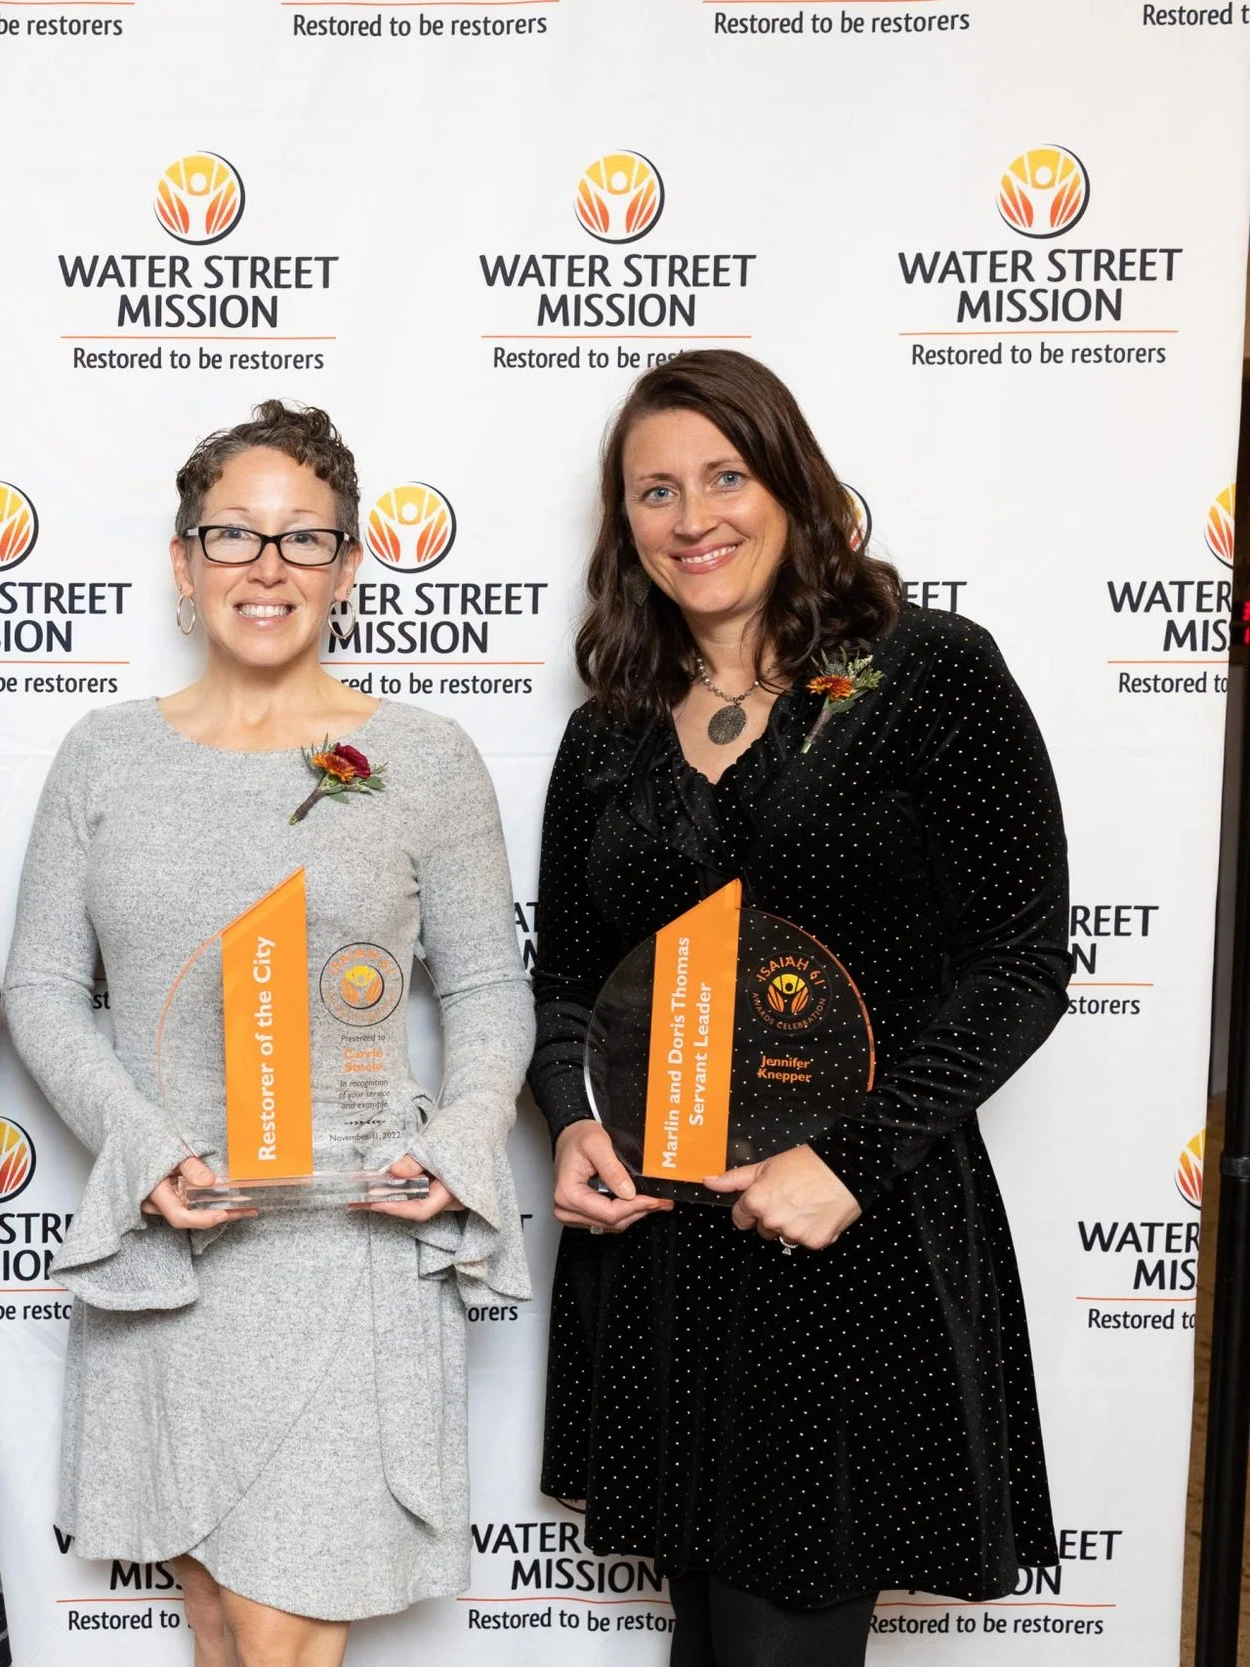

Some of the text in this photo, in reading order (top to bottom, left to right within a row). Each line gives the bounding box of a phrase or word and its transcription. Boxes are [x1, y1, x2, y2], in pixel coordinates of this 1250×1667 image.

[27, 15, 123, 36] restorers
[293, 13, 547, 37] Restored to be restorers
[714, 10, 970, 34] Restored to be restorers
[1142, 2, 1233, 26] Restored
[57, 254, 340, 289] WATER STREET
[479, 253, 757, 288] WATER STREET
[897, 248, 1184, 285] WATER STREET
[117, 293, 278, 329] MISSION
[537, 293, 696, 328] MISSION
[956, 287, 1123, 323] MISSION
[73, 346, 324, 370] Restored to be restorers
[493, 346, 580, 368] Restored
[587, 349, 609, 368] to
[617, 346, 640, 368] be
[912, 341, 1166, 366] Restored to be restorers
[414, 582, 549, 615] STREET
[1107, 580, 1232, 613] WATER
[328, 620, 489, 654] MISSION
[25, 673, 118, 693] restorers
[380, 675, 401, 694] to
[409, 672, 433, 694] be
[440, 675, 532, 694] restorers
[1118, 671, 1206, 693] Restored
[1070, 905, 1159, 937] REET
[756, 955, 827, 985] ISAIAH 61
[752, 992, 827, 1030] AWARDS CELEBRATION
[1068, 996, 1141, 1015] storers
[253, 937, 276, 1161] Restorer of the City
[340, 1033, 386, 1043] Presented to
[662, 937, 690, 1168] Marlin and Doris Thomas
[689, 983, 711, 1125] Servant Leader
[760, 1055, 811, 1069] Jennifer
[349, 1079, 389, 1088] recognition
[757, 1068, 813, 1084] Knepper
[338, 1090, 391, 1100] of your service
[341, 1101, 355, 1110] and
[329, 1133, 370, 1143] November
[1077, 1221, 1200, 1254] WATER
[1087, 1308, 1175, 1330] Restored
[511, 1557, 663, 1594] MISSION
[68, 1607, 180, 1631] Restored to
[468, 1606, 676, 1633] Restored to be restor
[956, 1615, 977, 1634] to
[982, 1613, 1007, 1635] be
[1013, 1615, 1104, 1636] restorers
